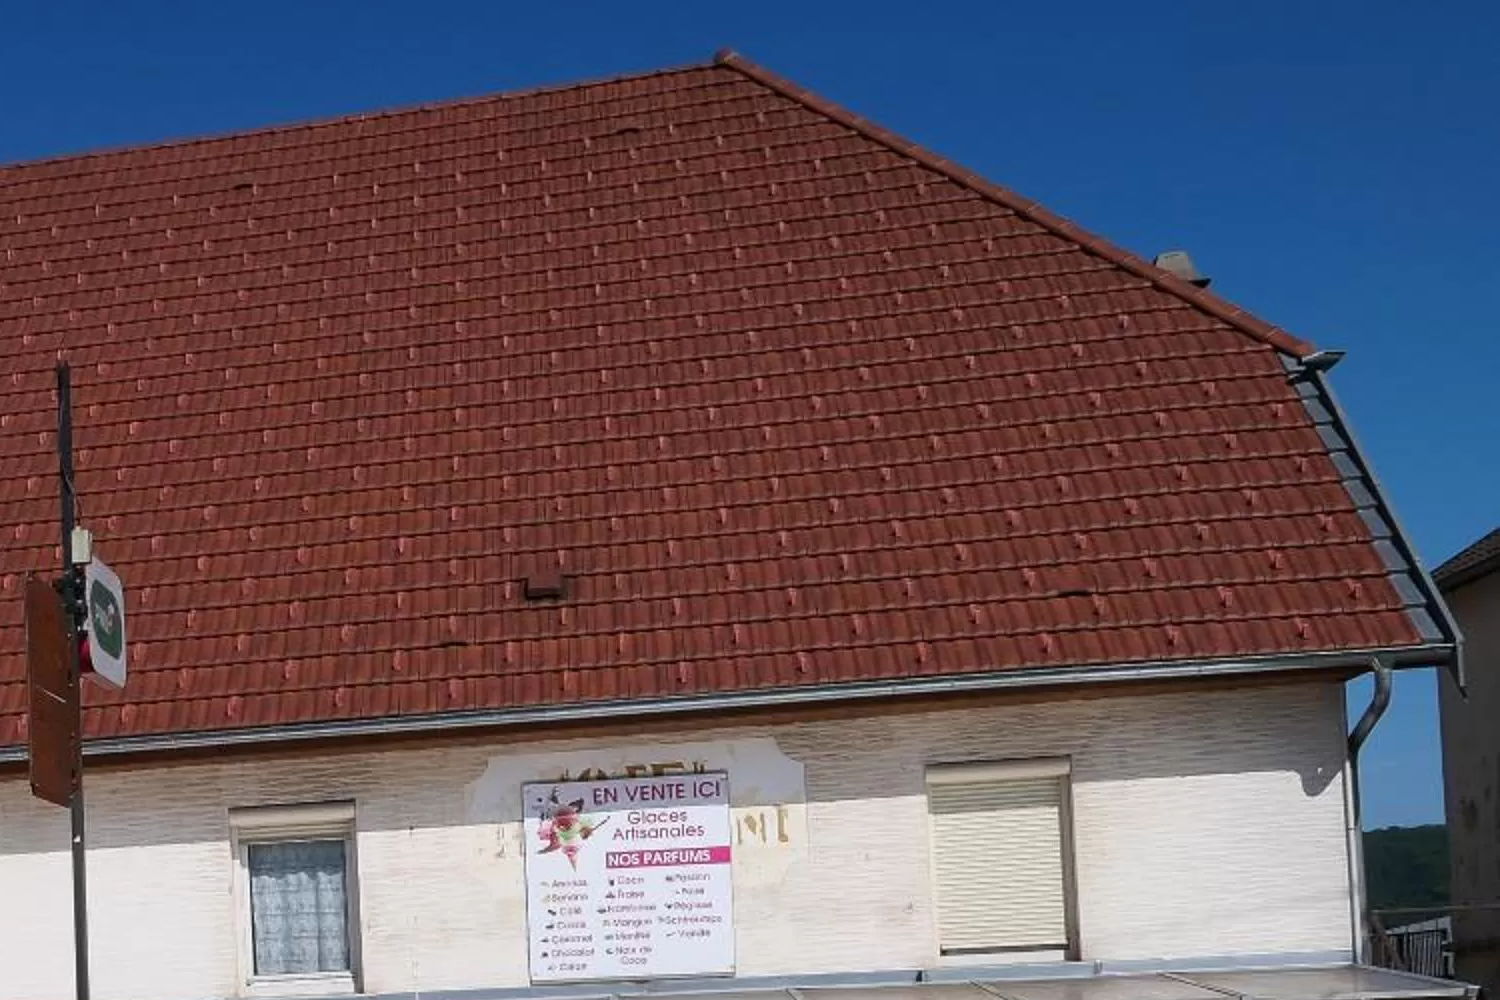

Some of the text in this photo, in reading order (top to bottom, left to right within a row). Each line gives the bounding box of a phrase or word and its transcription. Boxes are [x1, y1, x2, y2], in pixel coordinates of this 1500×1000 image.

[593, 781, 721, 805] EN VENTE ICI
[627, 809, 687, 824] Glaces
[612, 824, 705, 841] Artisanales
[607, 849, 711, 867] NOS PARFUMS
